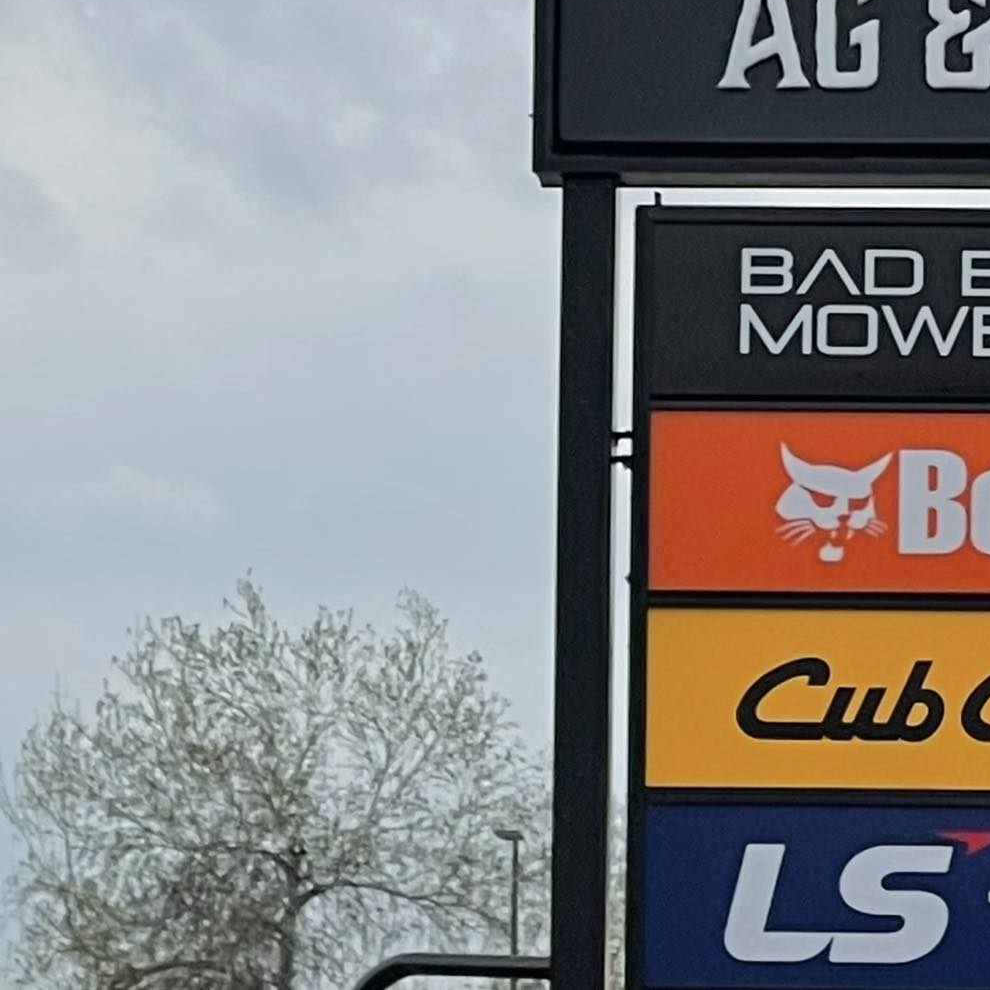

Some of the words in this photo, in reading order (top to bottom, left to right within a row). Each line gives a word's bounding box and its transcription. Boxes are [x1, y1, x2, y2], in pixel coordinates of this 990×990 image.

[739, 247, 925, 297] BAD
[735, 657, 945, 743] Cub
[723, 843, 955, 965] LS
